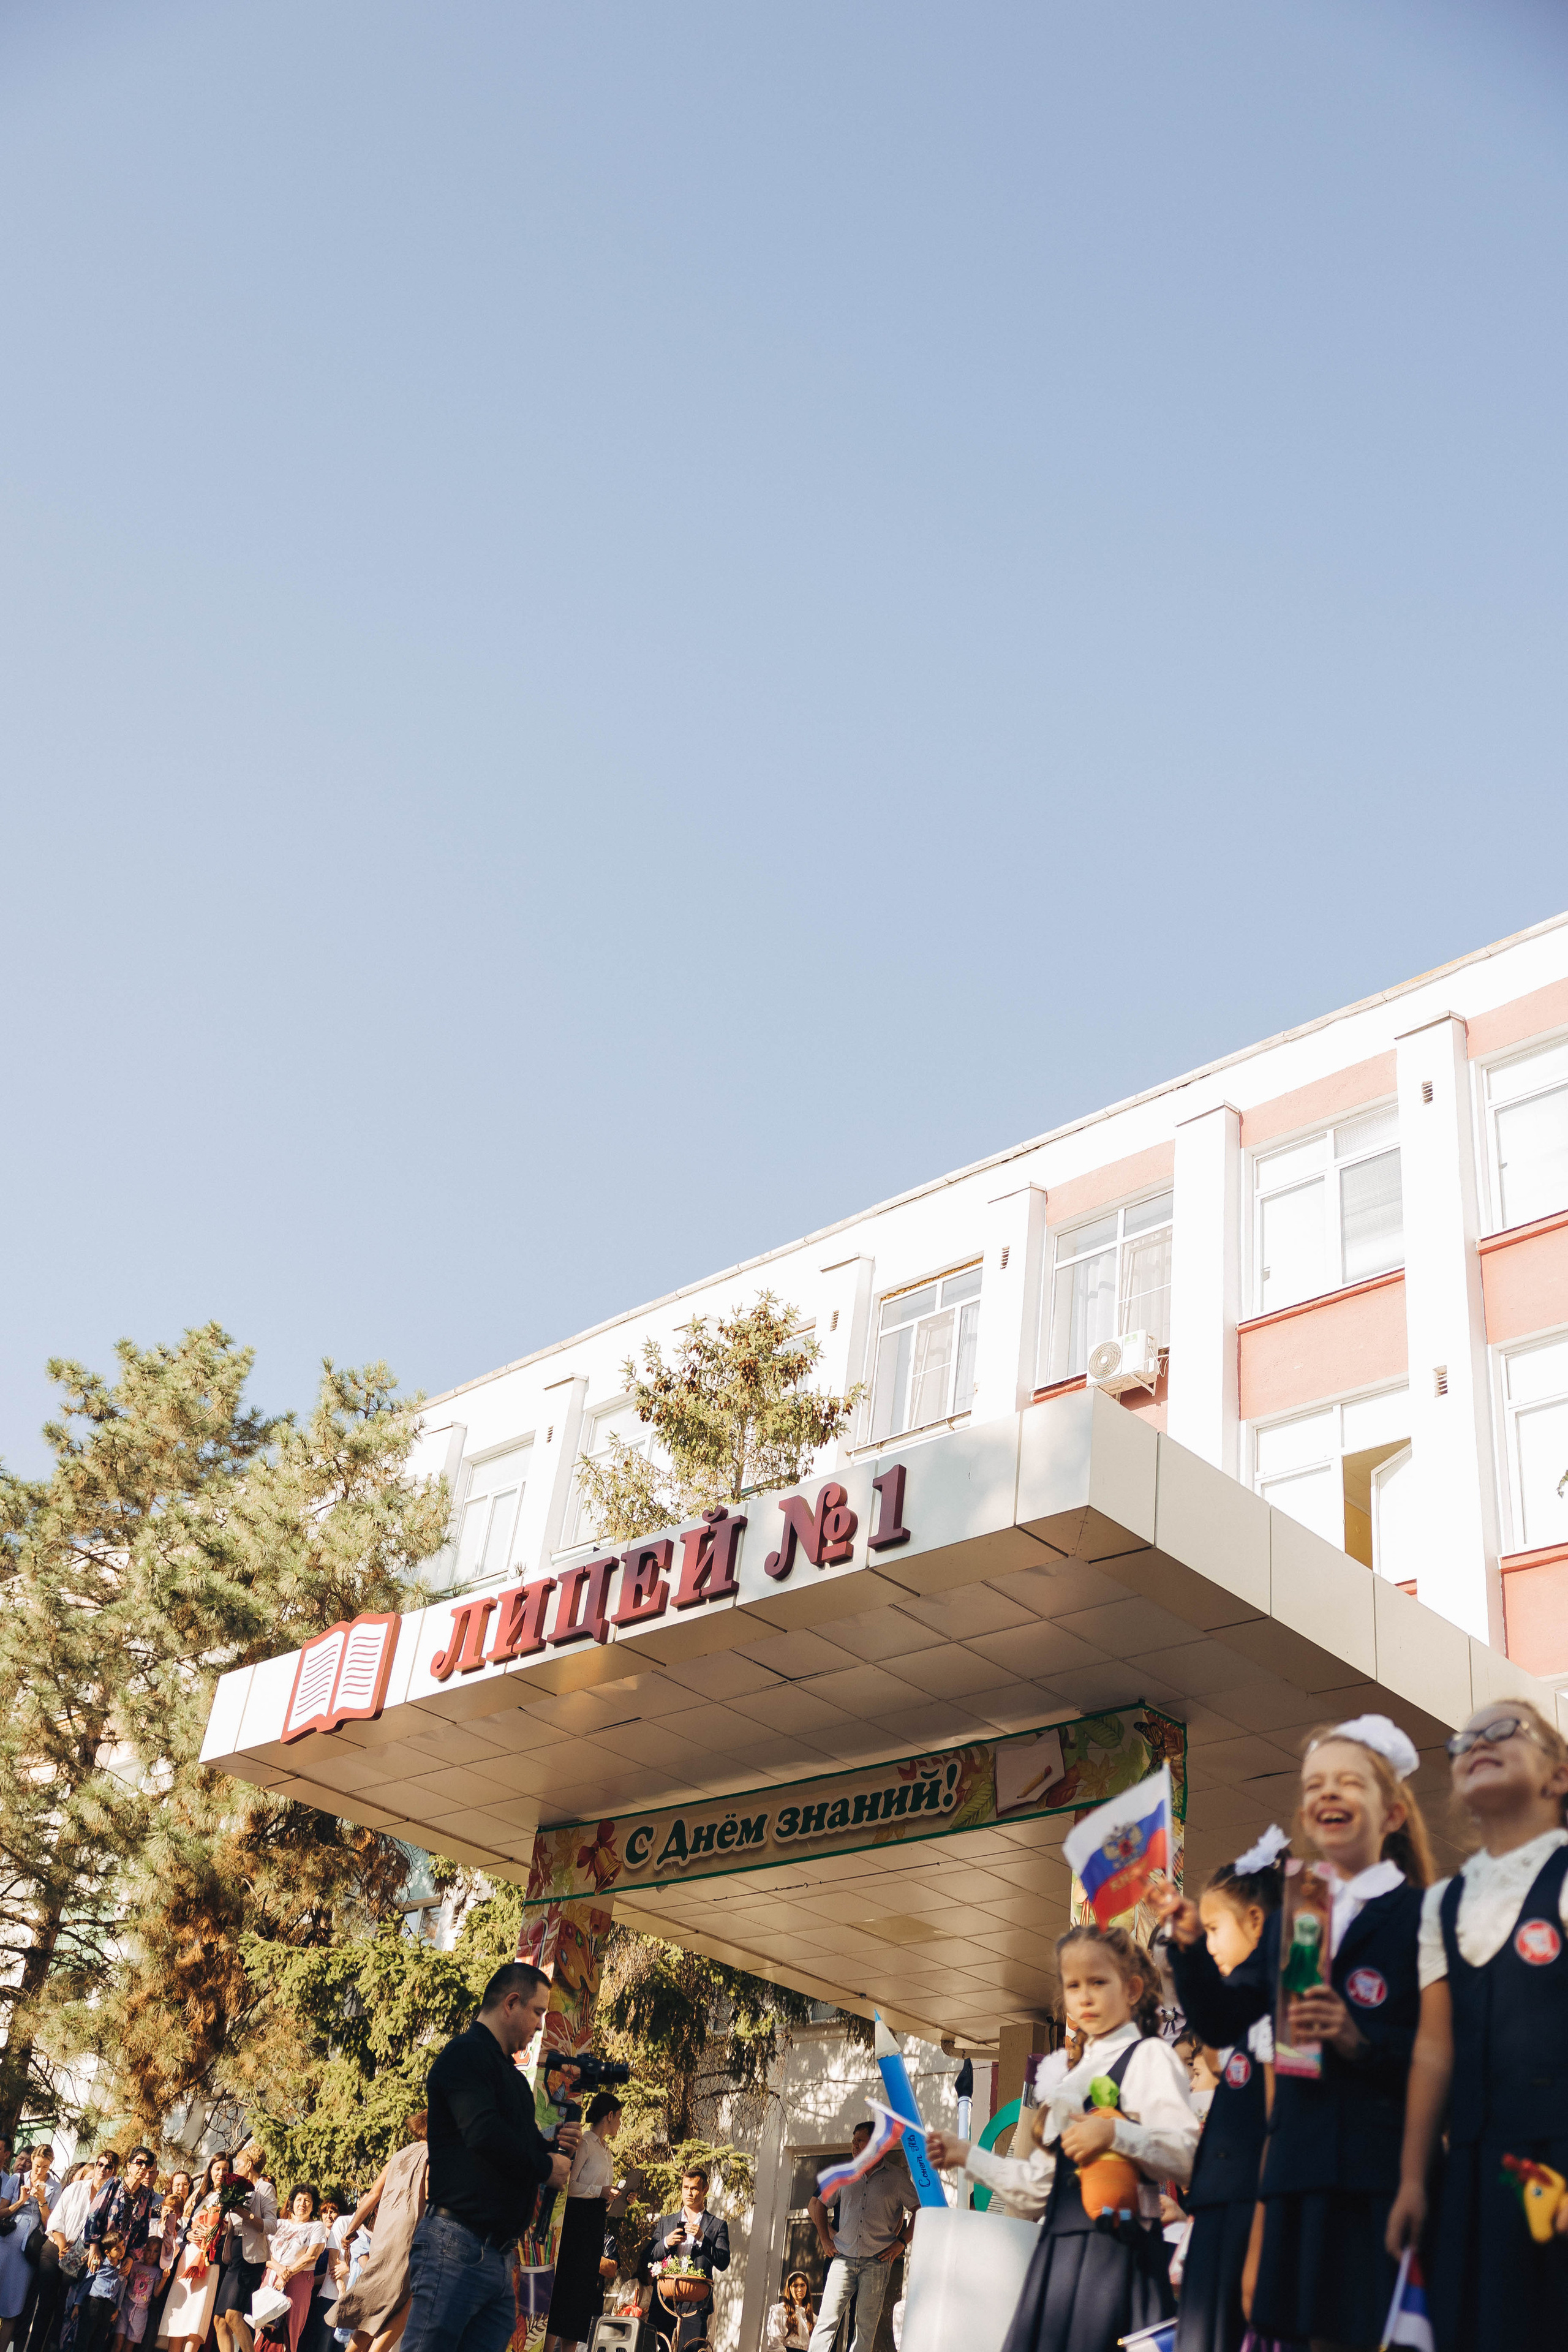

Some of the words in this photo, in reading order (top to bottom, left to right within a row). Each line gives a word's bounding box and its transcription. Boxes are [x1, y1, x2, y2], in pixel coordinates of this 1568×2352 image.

[430, 1504, 748, 1680] ЛИЦЕЙ
[625, 1826, 654, 1864] С
[657, 1813, 768, 1865] Днём
[776, 1763, 958, 1837] знаний!
[917, 2154, 930, 2188] Сонет
